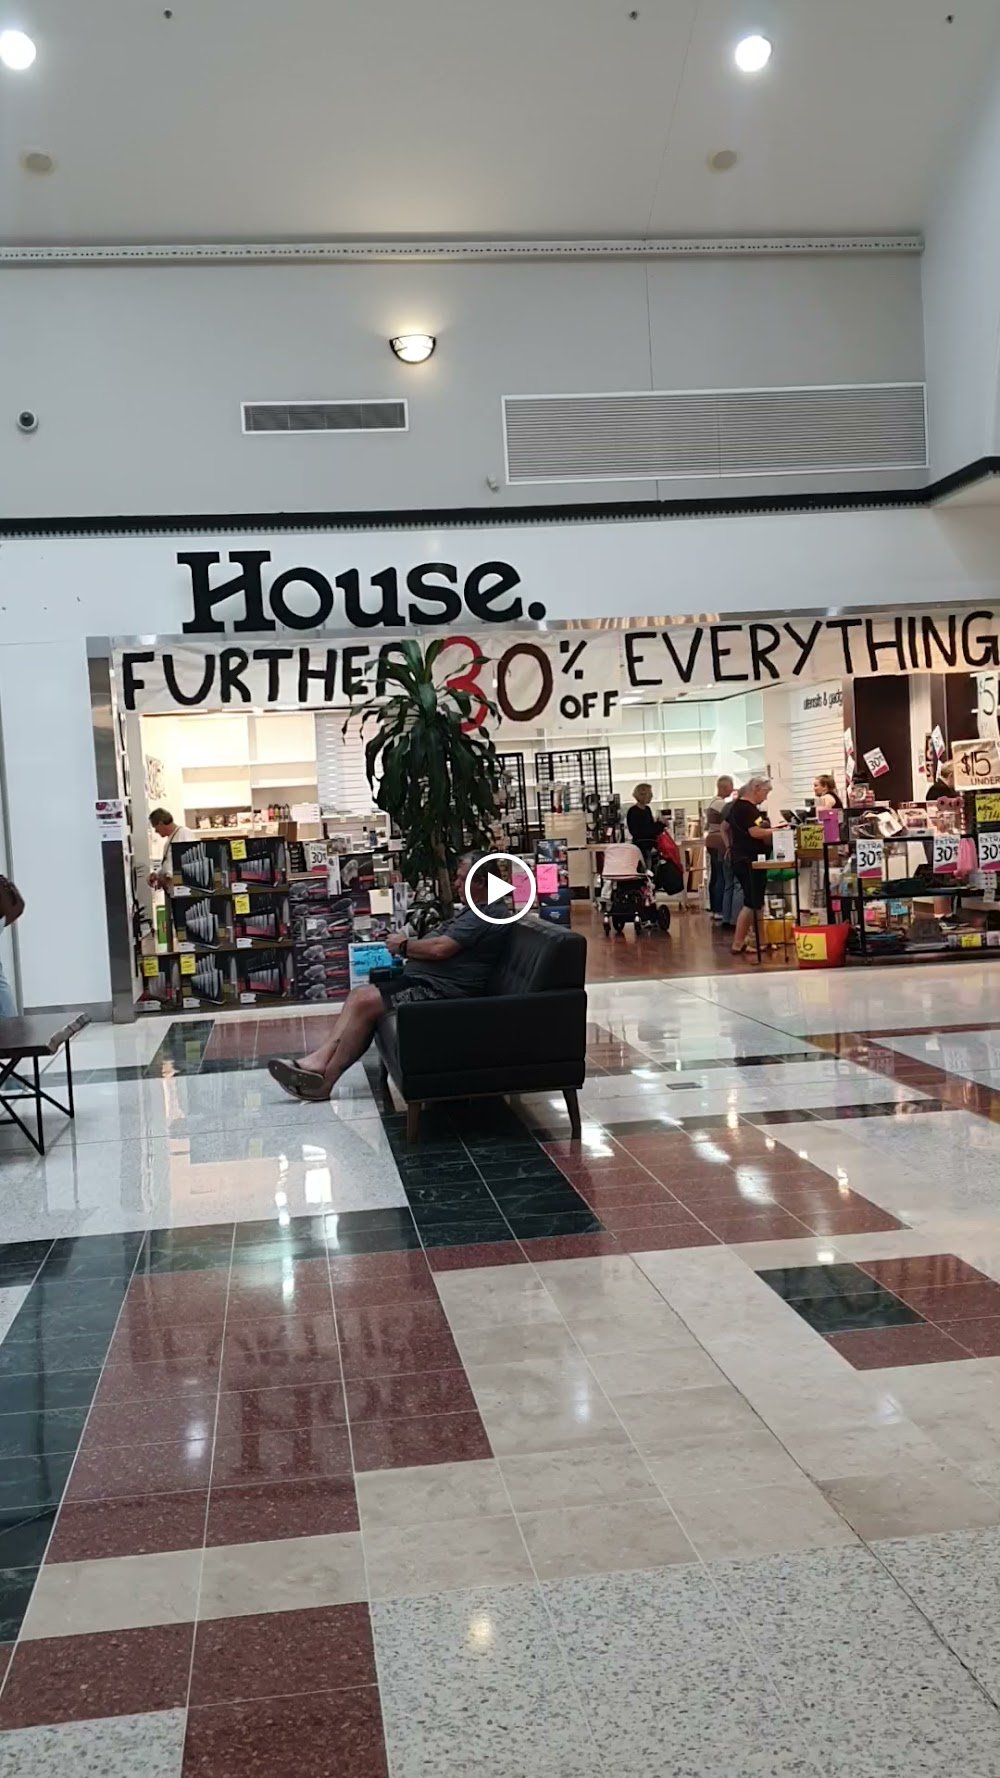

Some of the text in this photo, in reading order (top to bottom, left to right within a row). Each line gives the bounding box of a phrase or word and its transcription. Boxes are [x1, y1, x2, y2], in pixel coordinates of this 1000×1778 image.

[176, 550, 547, 634] House.
[624, 610, 1000, 686] EVERYTHING
[559, 690, 619, 719] OFF
[961, 751, 991, 777] $15
